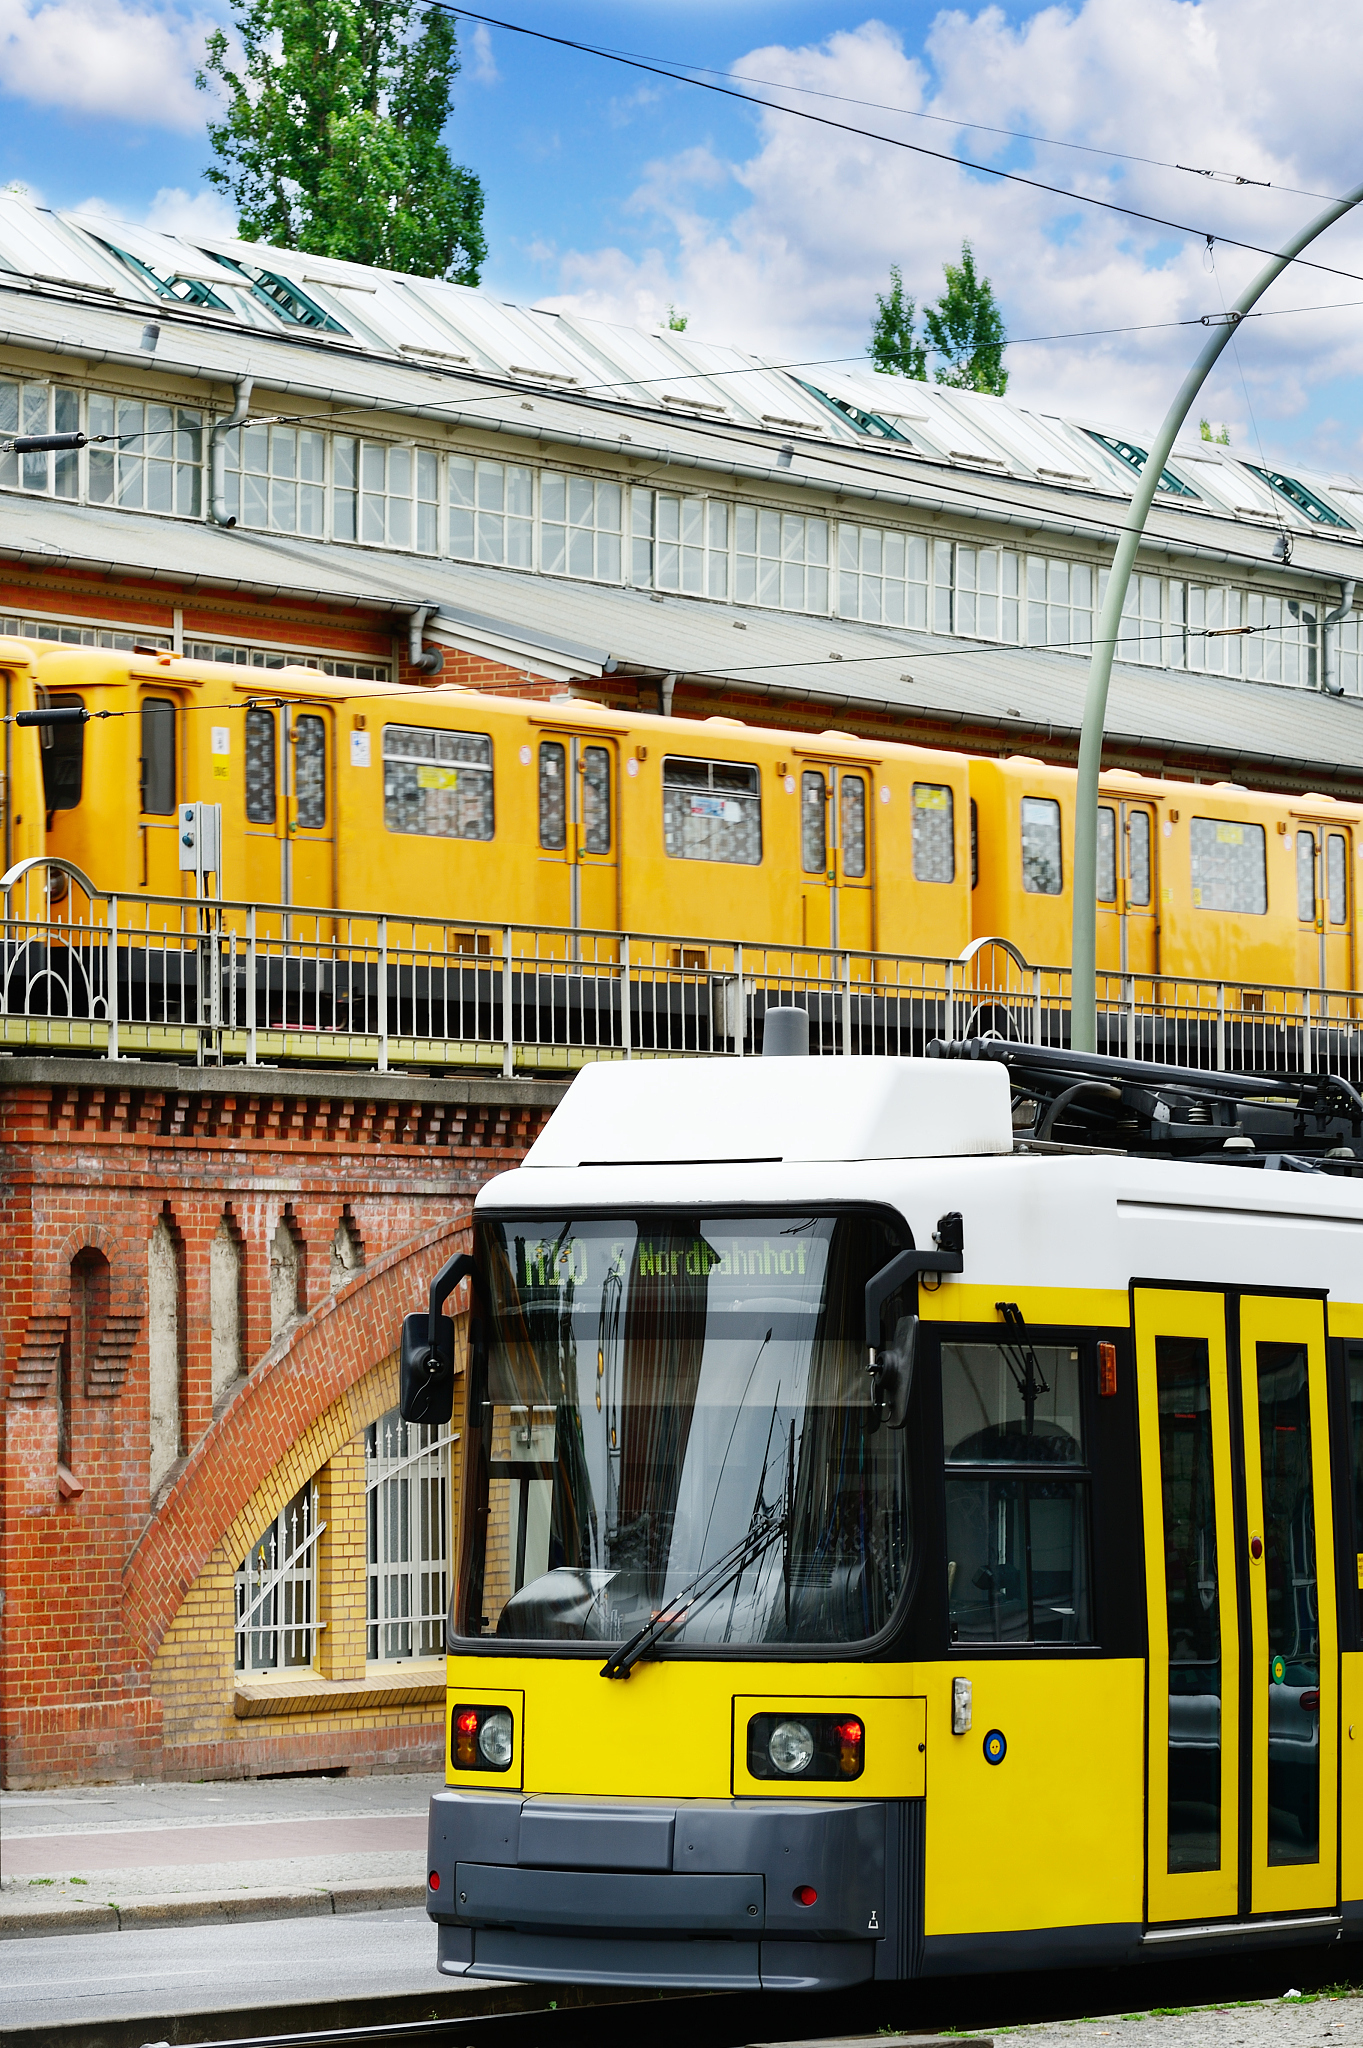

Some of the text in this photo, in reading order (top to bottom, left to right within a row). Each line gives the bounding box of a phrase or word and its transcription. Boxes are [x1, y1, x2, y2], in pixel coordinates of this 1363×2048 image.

[525, 1238, 807, 1286] M10 S Nordbahnhof
